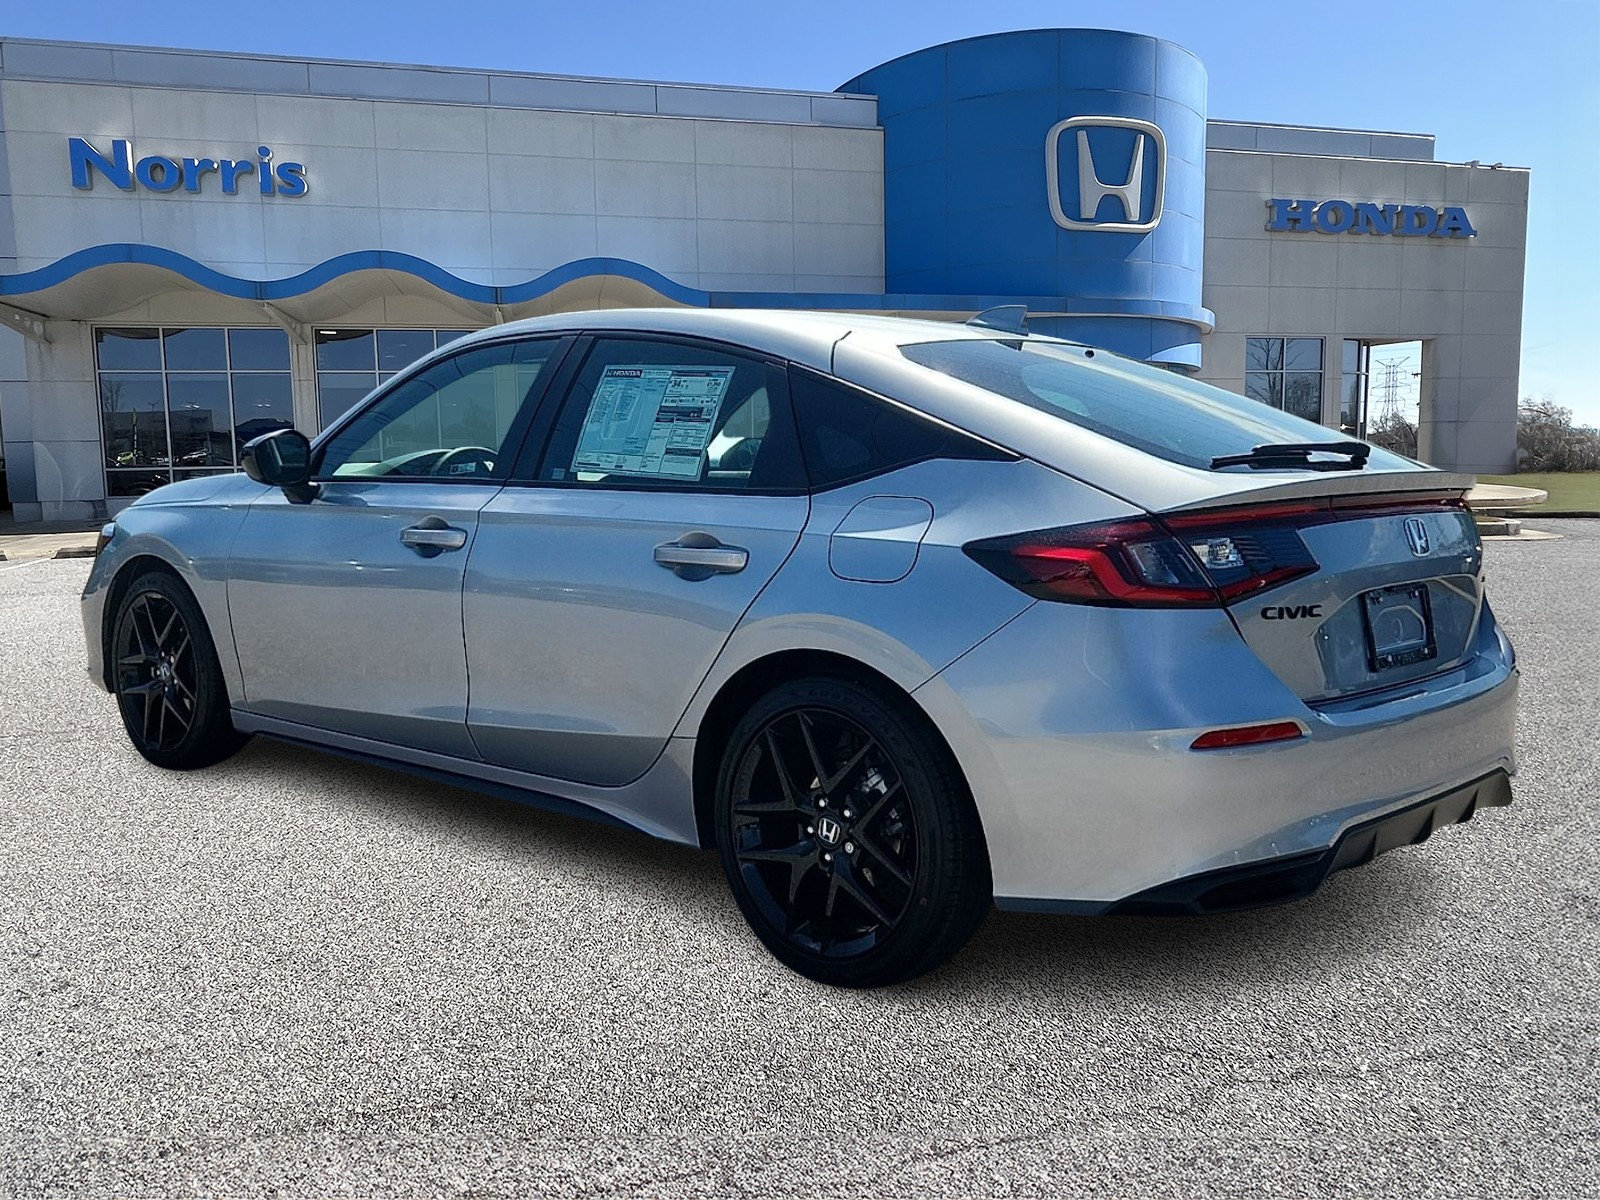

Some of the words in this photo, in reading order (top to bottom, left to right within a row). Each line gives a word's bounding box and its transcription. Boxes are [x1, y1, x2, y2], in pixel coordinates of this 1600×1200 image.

[68, 137, 309, 197] Norris
[1265, 197, 1478, 239] HONDA
[1260, 604, 1323, 621] CIVIC
